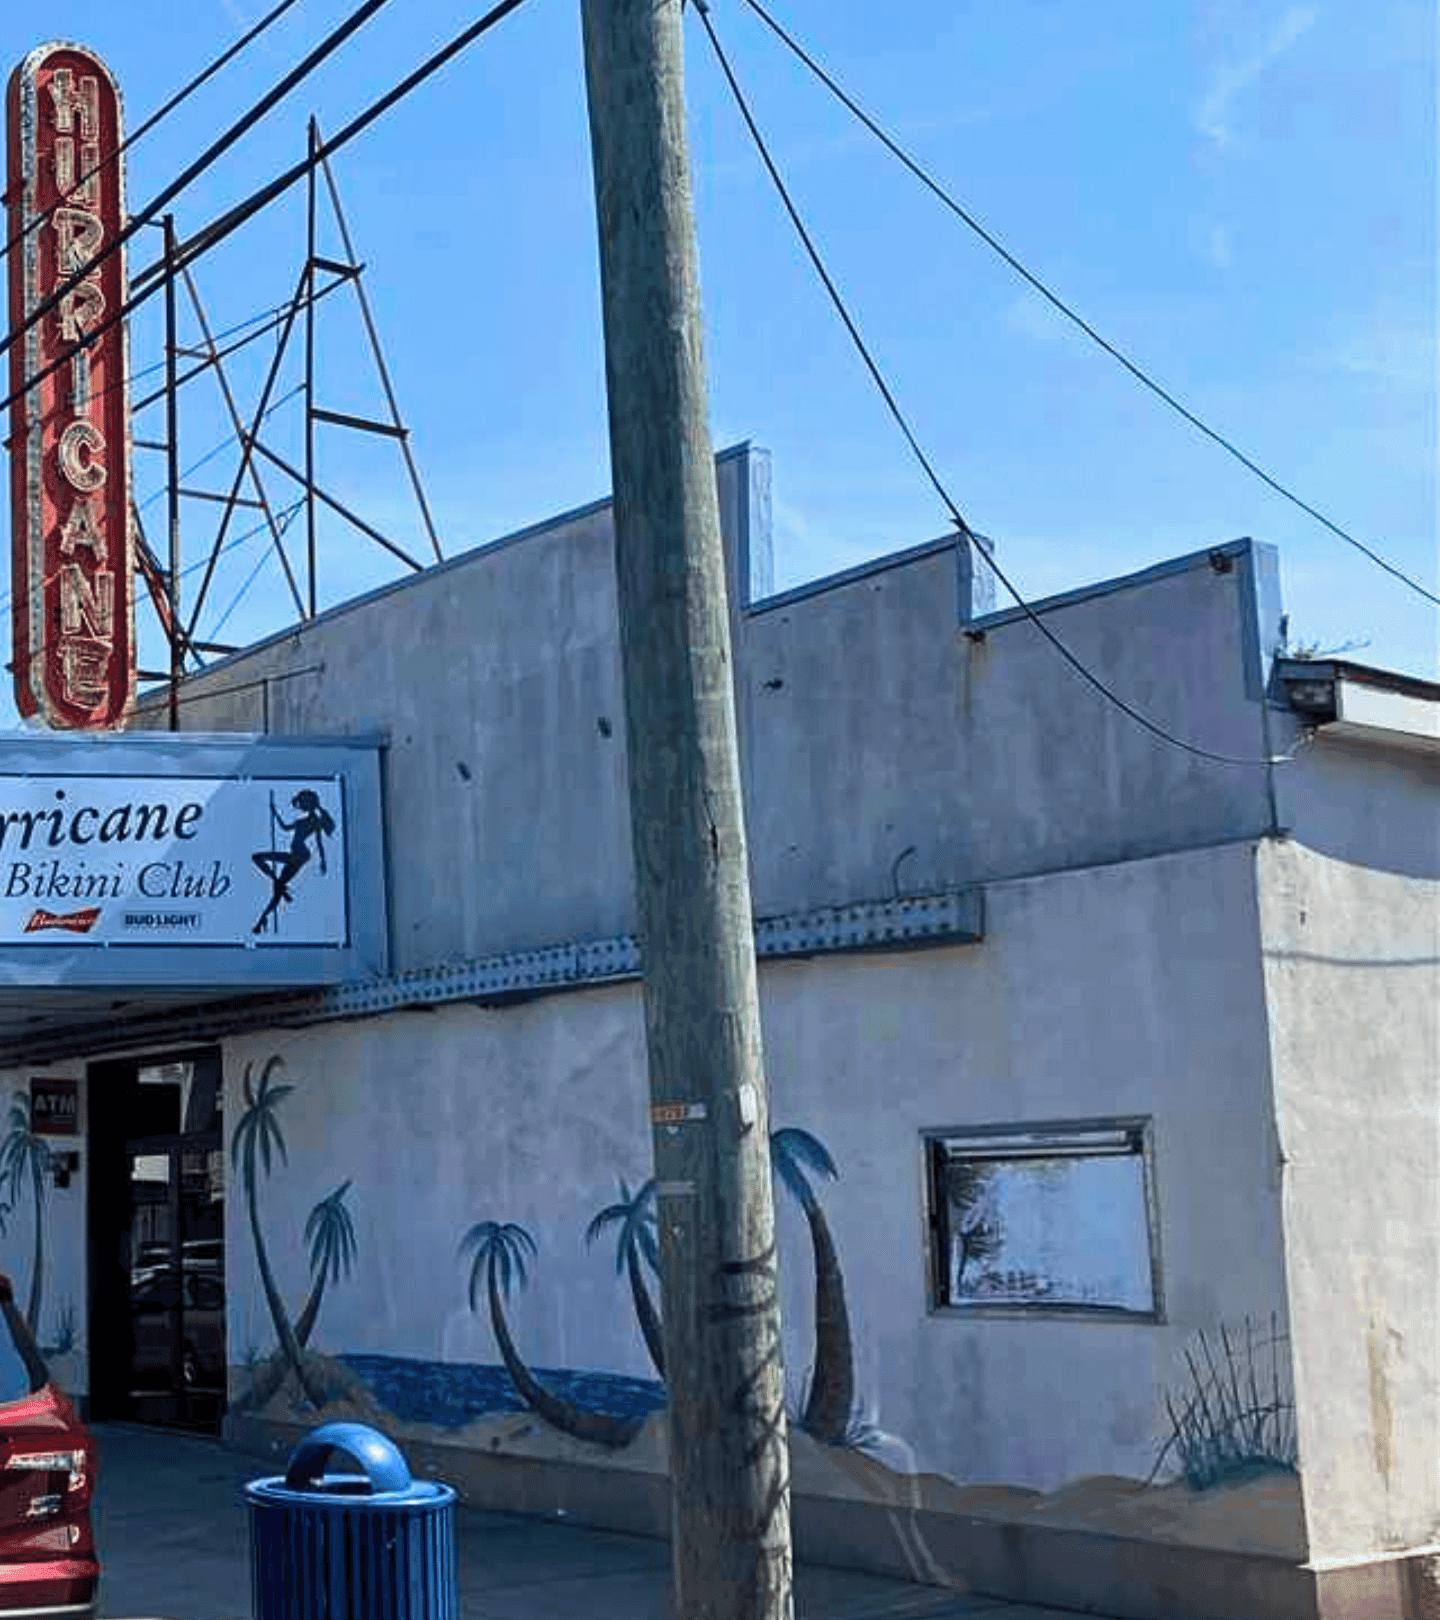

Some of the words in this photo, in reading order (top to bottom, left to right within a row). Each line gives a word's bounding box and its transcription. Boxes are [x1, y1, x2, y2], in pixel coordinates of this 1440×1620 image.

[51, 68, 111, 712] HURRICANE
[4, 860, 126, 899] Bikini
[136, 860, 232, 899] Club
[124, 914, 154, 927] BUD
[155, 914, 198, 927] LIGHT
[34, 1094, 76, 1116] ATM
